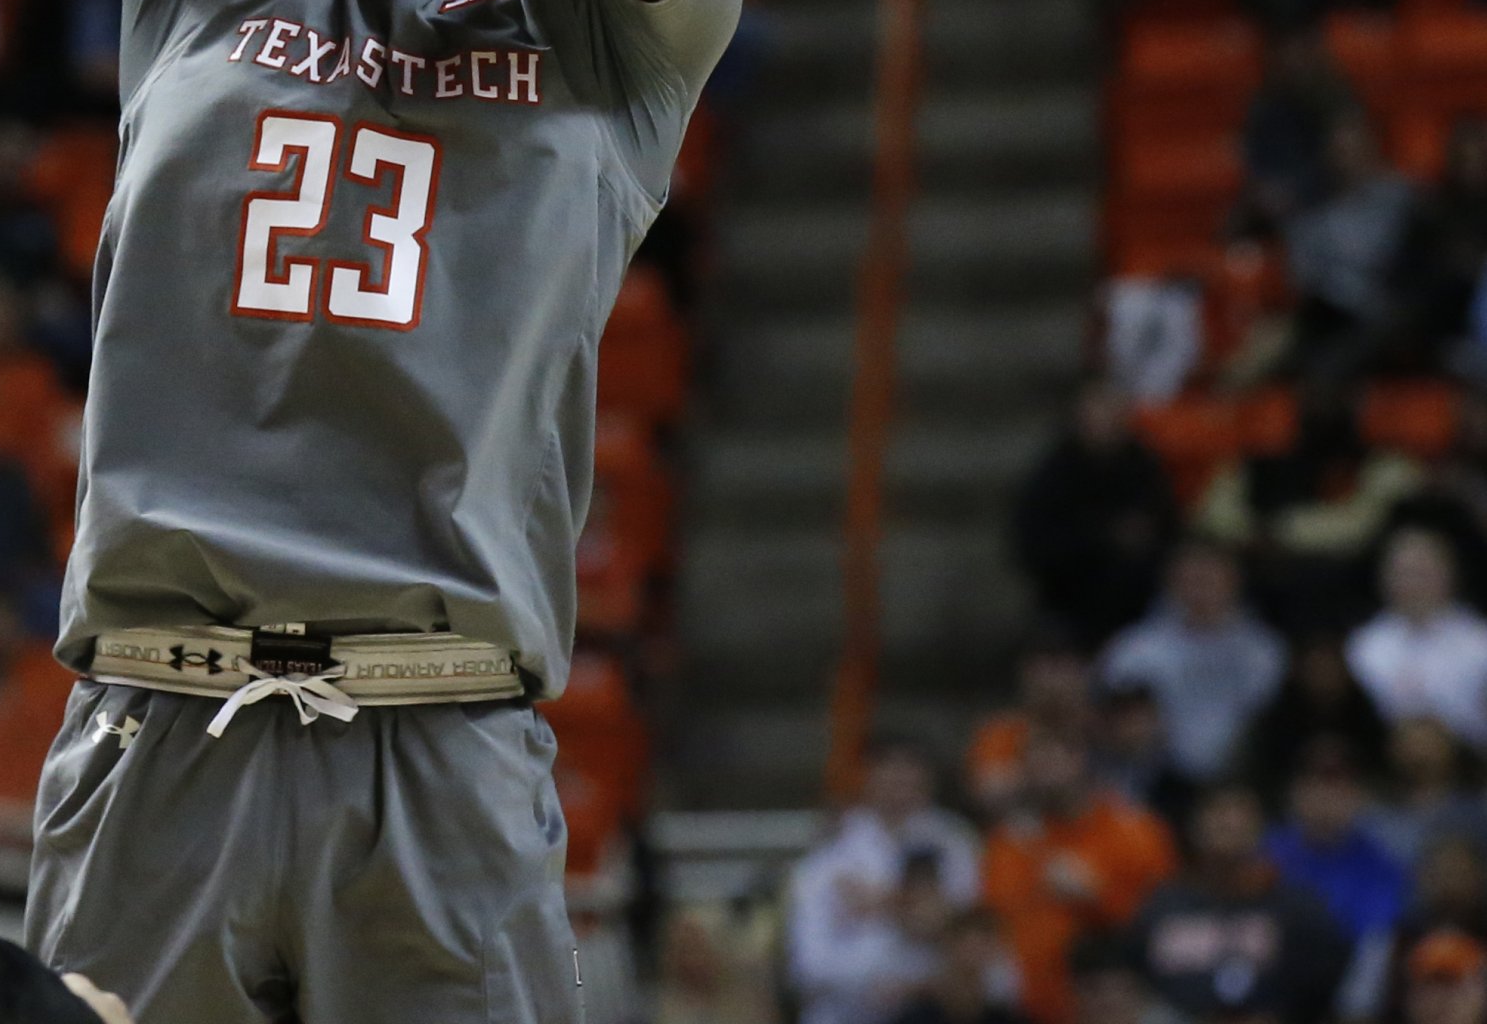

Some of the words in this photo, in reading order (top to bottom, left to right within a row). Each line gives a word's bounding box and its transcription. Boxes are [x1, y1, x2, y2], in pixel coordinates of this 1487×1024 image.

[228, 17, 389, 89] TEXAS
[391, 50, 544, 104] TECH
[231, 108, 443, 332] 23
[356, 661, 445, 680] ARMOUR
[452, 657, 509, 675] UNDER
